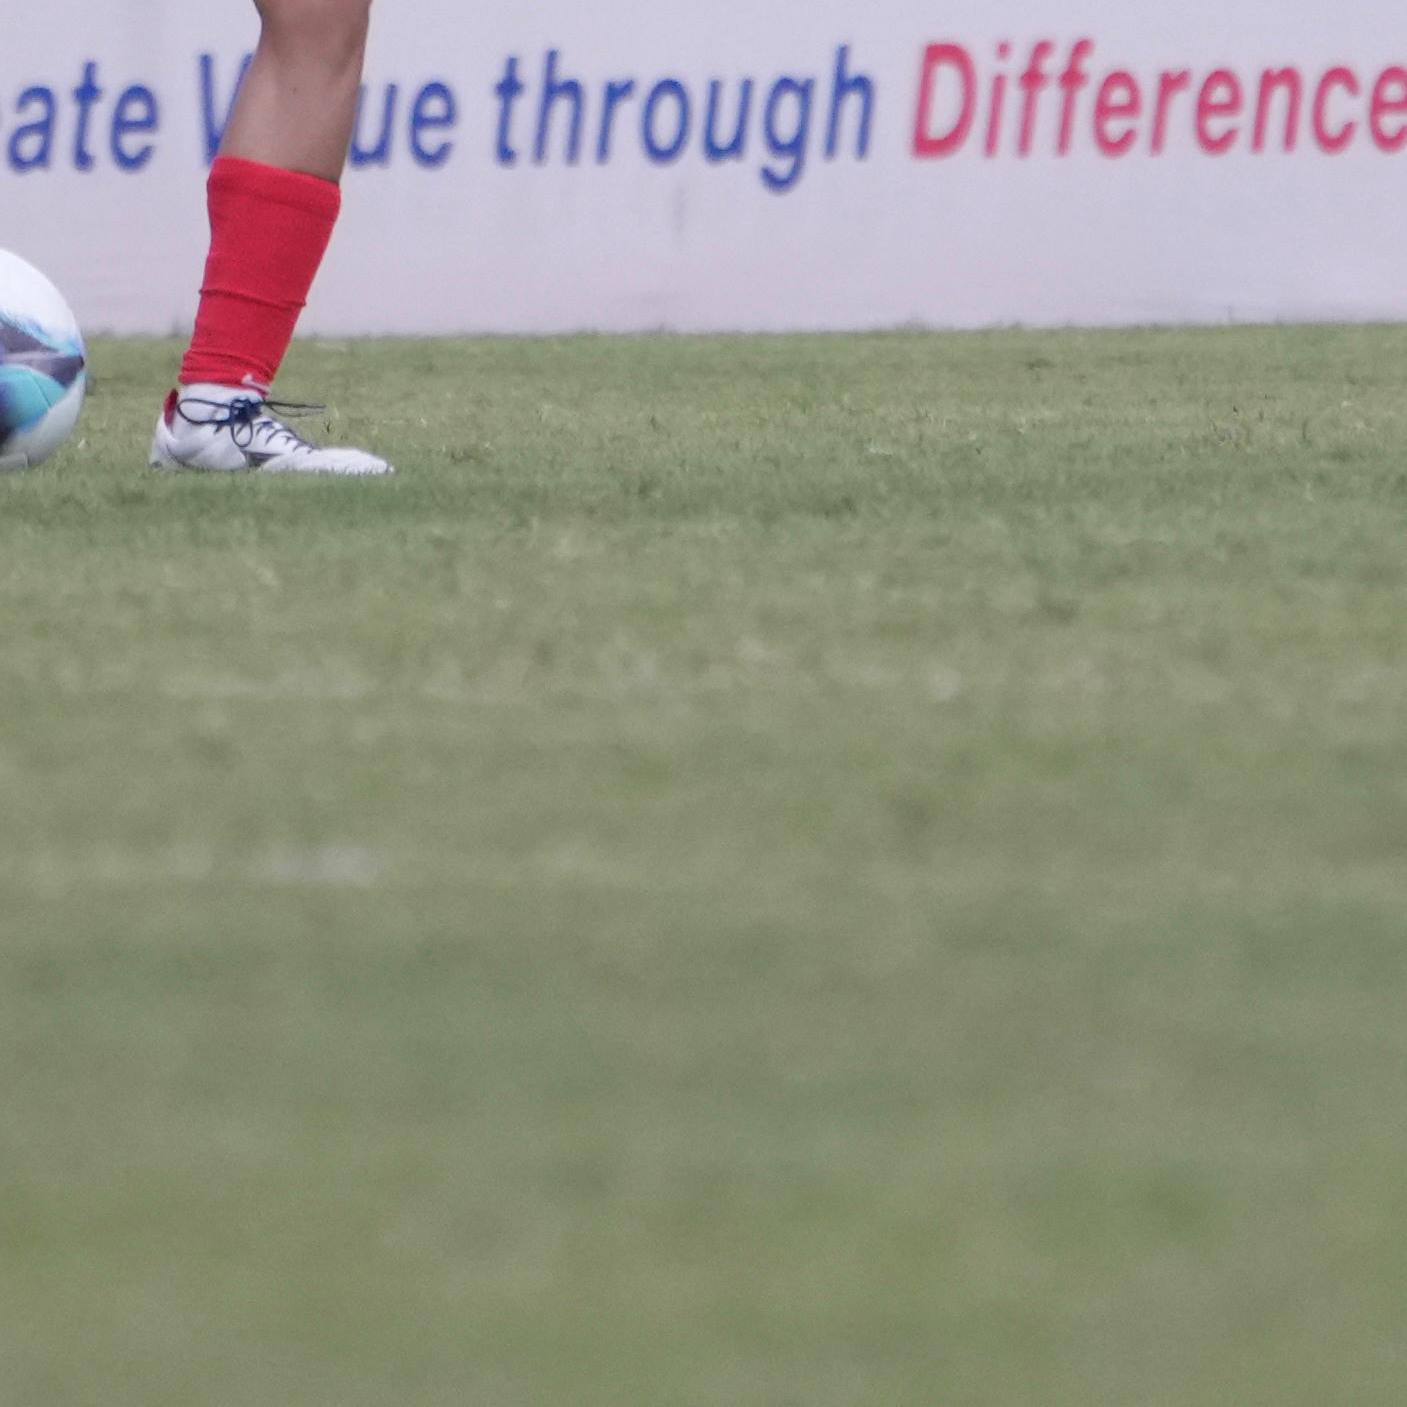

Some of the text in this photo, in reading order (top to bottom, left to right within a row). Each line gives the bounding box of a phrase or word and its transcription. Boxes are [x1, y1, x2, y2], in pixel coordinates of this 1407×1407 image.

[200, 52, 457, 169] Vue
[495, 46, 875, 192] through
[911, 37, 1407, 159] Difference
